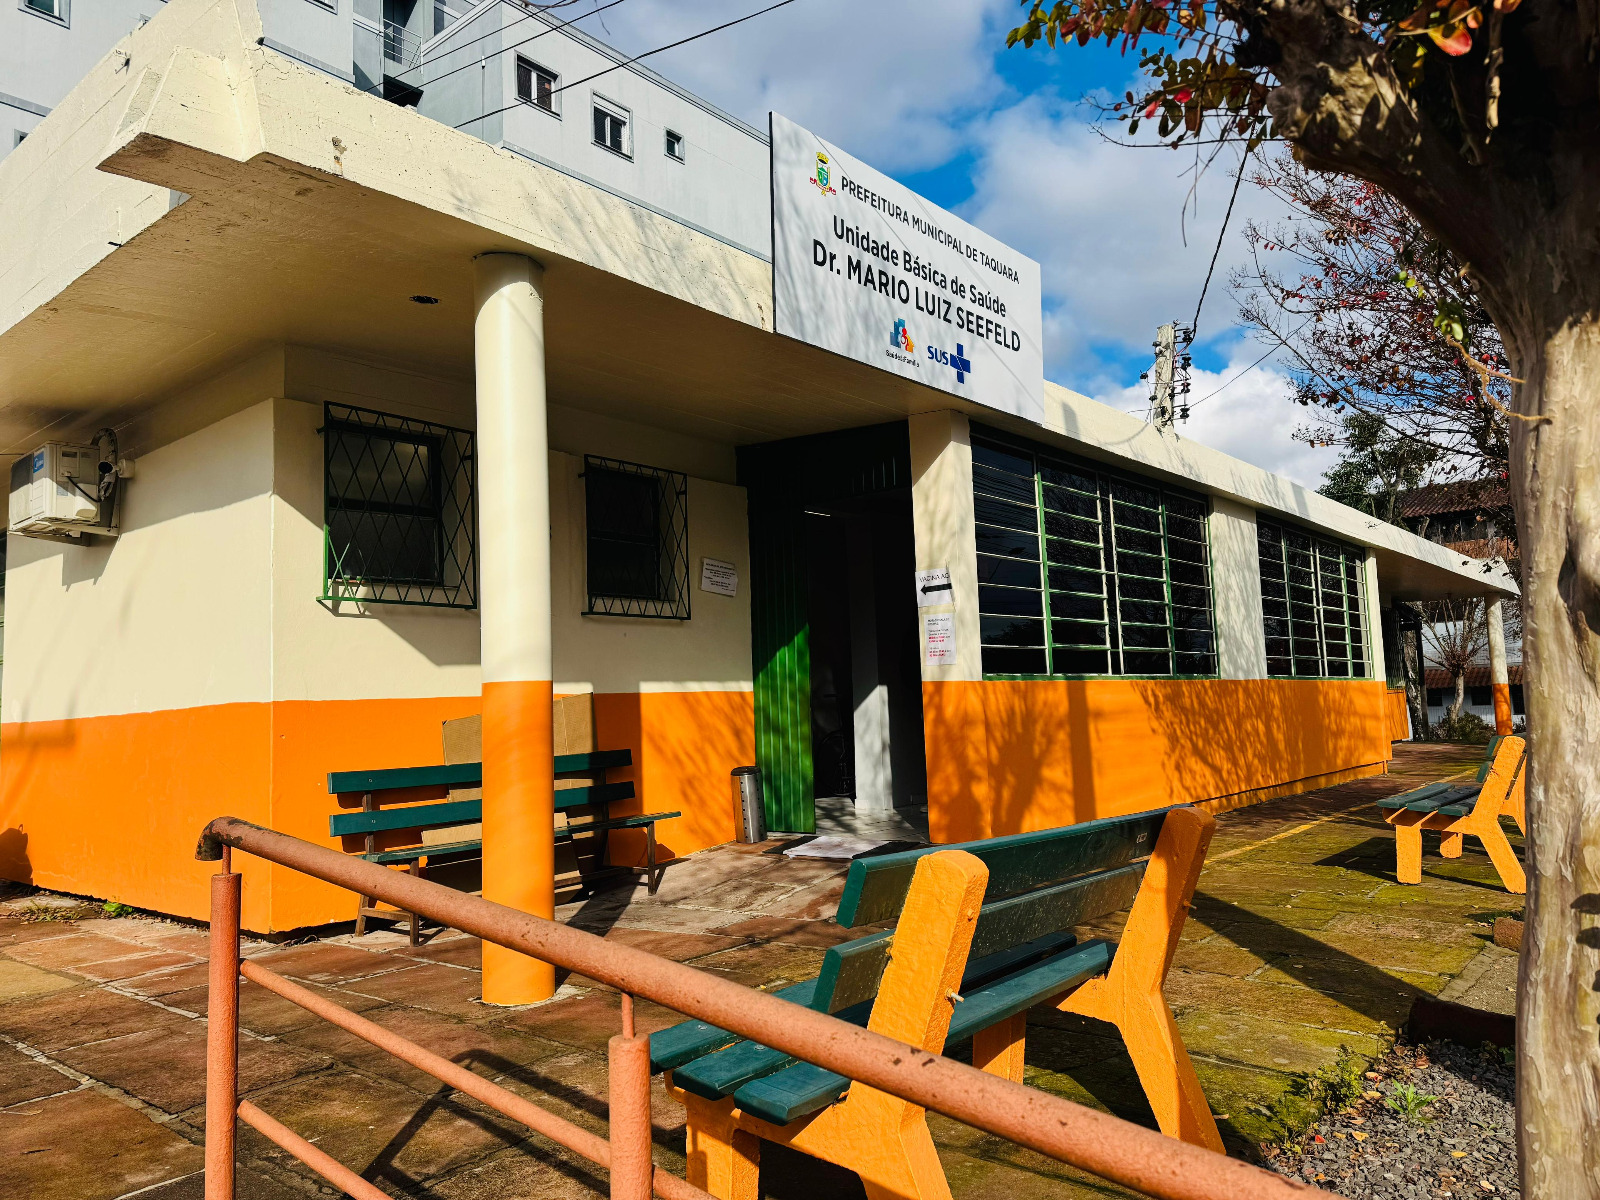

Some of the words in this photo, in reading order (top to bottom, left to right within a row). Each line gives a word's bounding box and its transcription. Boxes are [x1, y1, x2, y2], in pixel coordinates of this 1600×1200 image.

[833, 215, 899, 266] Unidade
[903, 250, 946, 290] Básica
[951, 276, 966, 299] de
[969, 284, 1006, 317] Saúde
[841, 176, 909, 226] PREFEITURA
[912, 214, 964, 257] MUNICIPAL
[966, 244, 978, 262] DE
[979, 251, 1019, 284] TAQUARA
[813, 239, 841, 275] Dr.
[848, 255, 910, 304] MARIO
[915, 286, 952, 324] LUIZ
[956, 306, 1021, 351] SEEFELD
[927, 345, 949, 366] SUS
